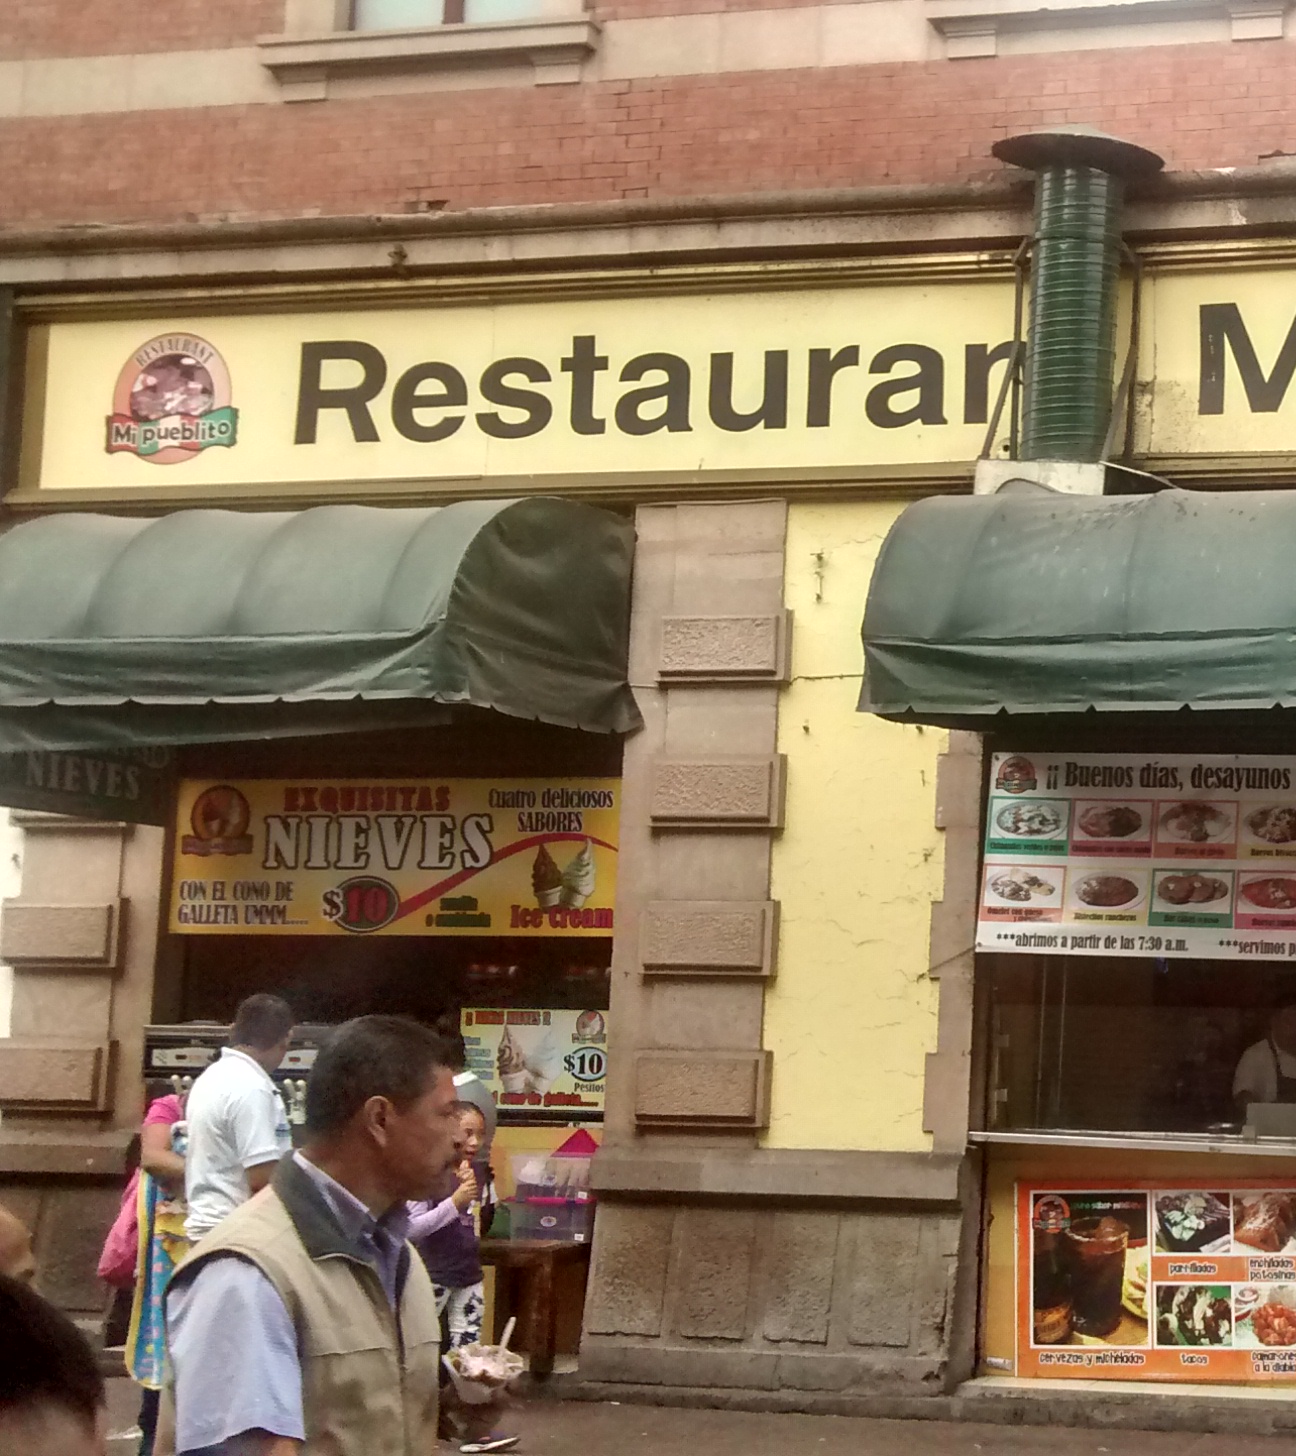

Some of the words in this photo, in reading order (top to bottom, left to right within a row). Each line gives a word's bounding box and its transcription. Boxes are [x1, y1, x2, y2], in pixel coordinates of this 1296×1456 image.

[293, 335, 1027, 445] Restauran
[113, 424, 138, 444] Mi
[142, 421, 231, 445] pueblito
[1064, 761, 1134, 788] Buenos
[1139, 761, 1184, 792] días,
[1190, 763, 1292, 793] desayunos
[283, 786, 451, 812] EXQUISITAS
[488, 787, 537, 809] Cuatro
[541, 787, 614, 809] deliciosos
[517, 810, 583, 833] SABORES
[262, 812, 495, 871] NIEVES
[180, 880, 207, 901] CON
[212, 880, 226, 901] EL
[233, 880, 271, 901] CONO
[275, 880, 294, 901] DE
[178, 903, 239, 925] GALLETA
[321, 886, 388, 923] $10
[510, 904, 543, 929] Ice
[1060, 936, 1068, 948] a
[1070, 934, 1102, 951] partir
[1103, 936, 1117, 950] de
[1120, 937, 1135, 950] las
[1138, 936, 1163, 951] 7:30
[1164, 938, 1189, 951] a.m.
[563, 1052, 603, 1075] $10
[1169, 1262, 1217, 1275] parrilladas
[1249, 1258, 1294, 1269] enchiladas
[1039, 1352, 1084, 1364] cervezas
[1085, 1355, 1093, 1366] y
[1095, 1352, 1146, 1365] micheladas
[1180, 1354, 1208, 1365] tacos
[1254, 1363, 1261, 1373] a
[1262, 1361, 1271, 1373] la
